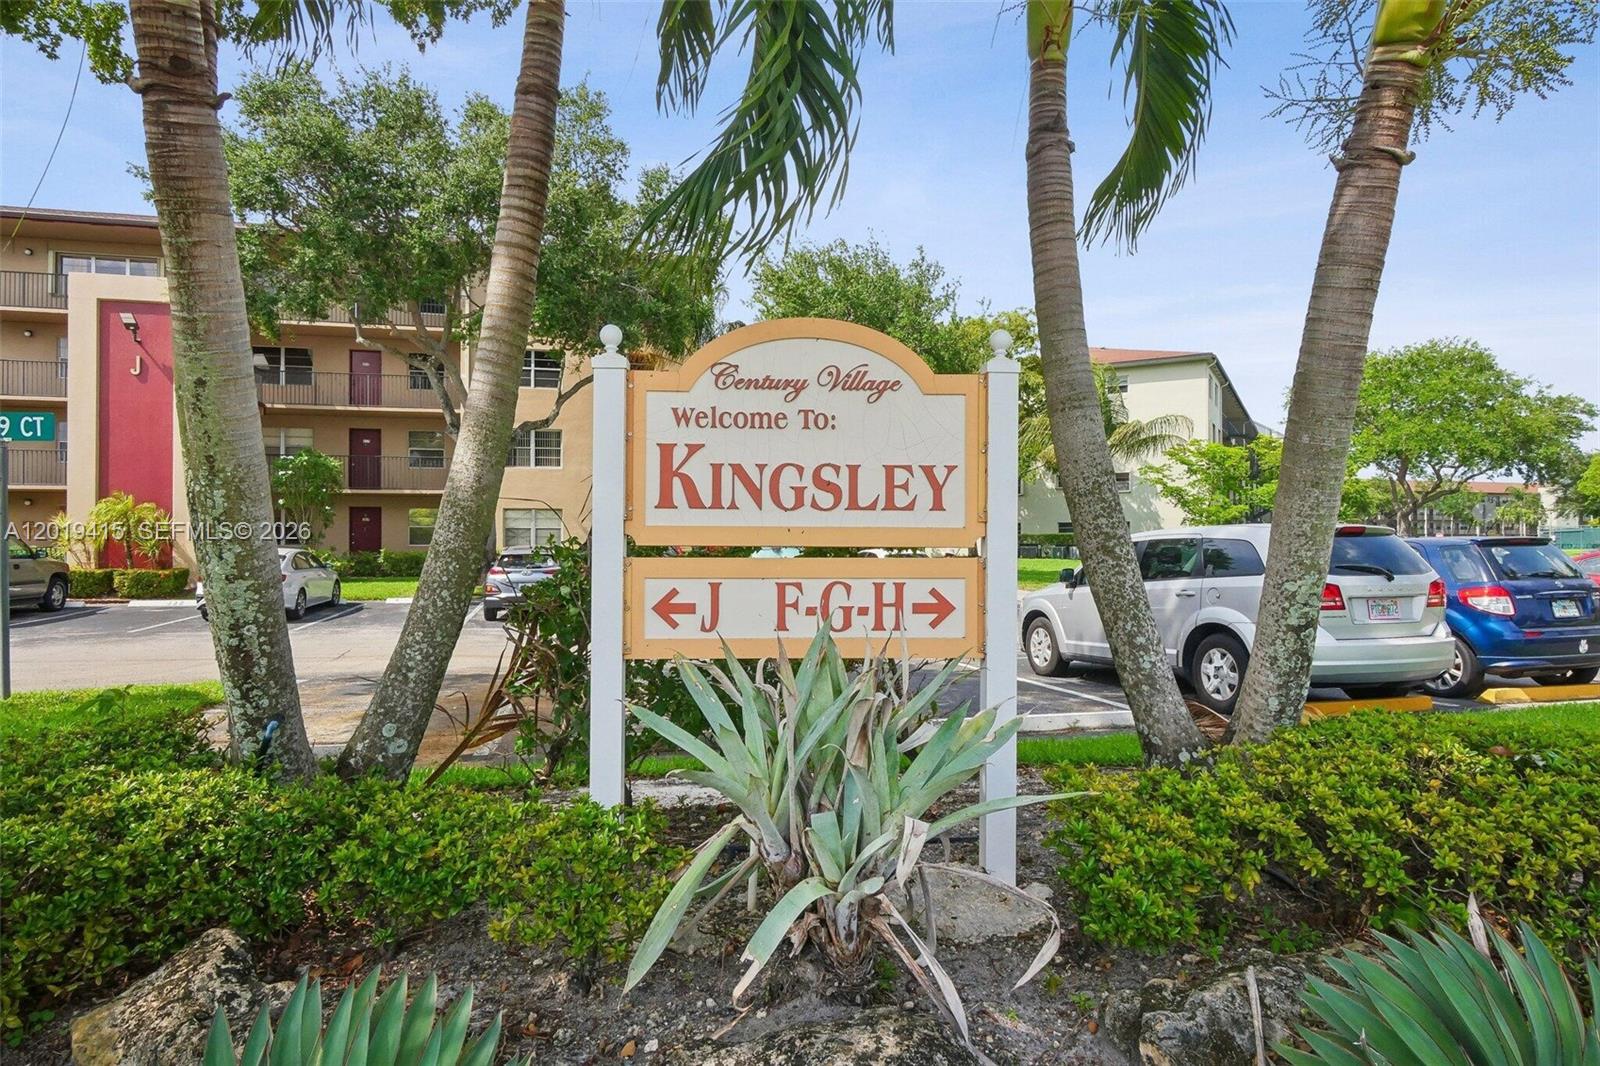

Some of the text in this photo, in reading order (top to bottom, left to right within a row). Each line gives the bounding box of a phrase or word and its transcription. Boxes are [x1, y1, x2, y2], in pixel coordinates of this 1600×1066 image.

[130, 355, 142, 375] J
[710, 362, 902, 404] Century Village
[20, 416, 45, 437] CT
[671, 406, 837, 431] Welcome To:
[654, 442, 959, 512] KINGSLEY
[700, 580, 908, 633] J F-G-H
